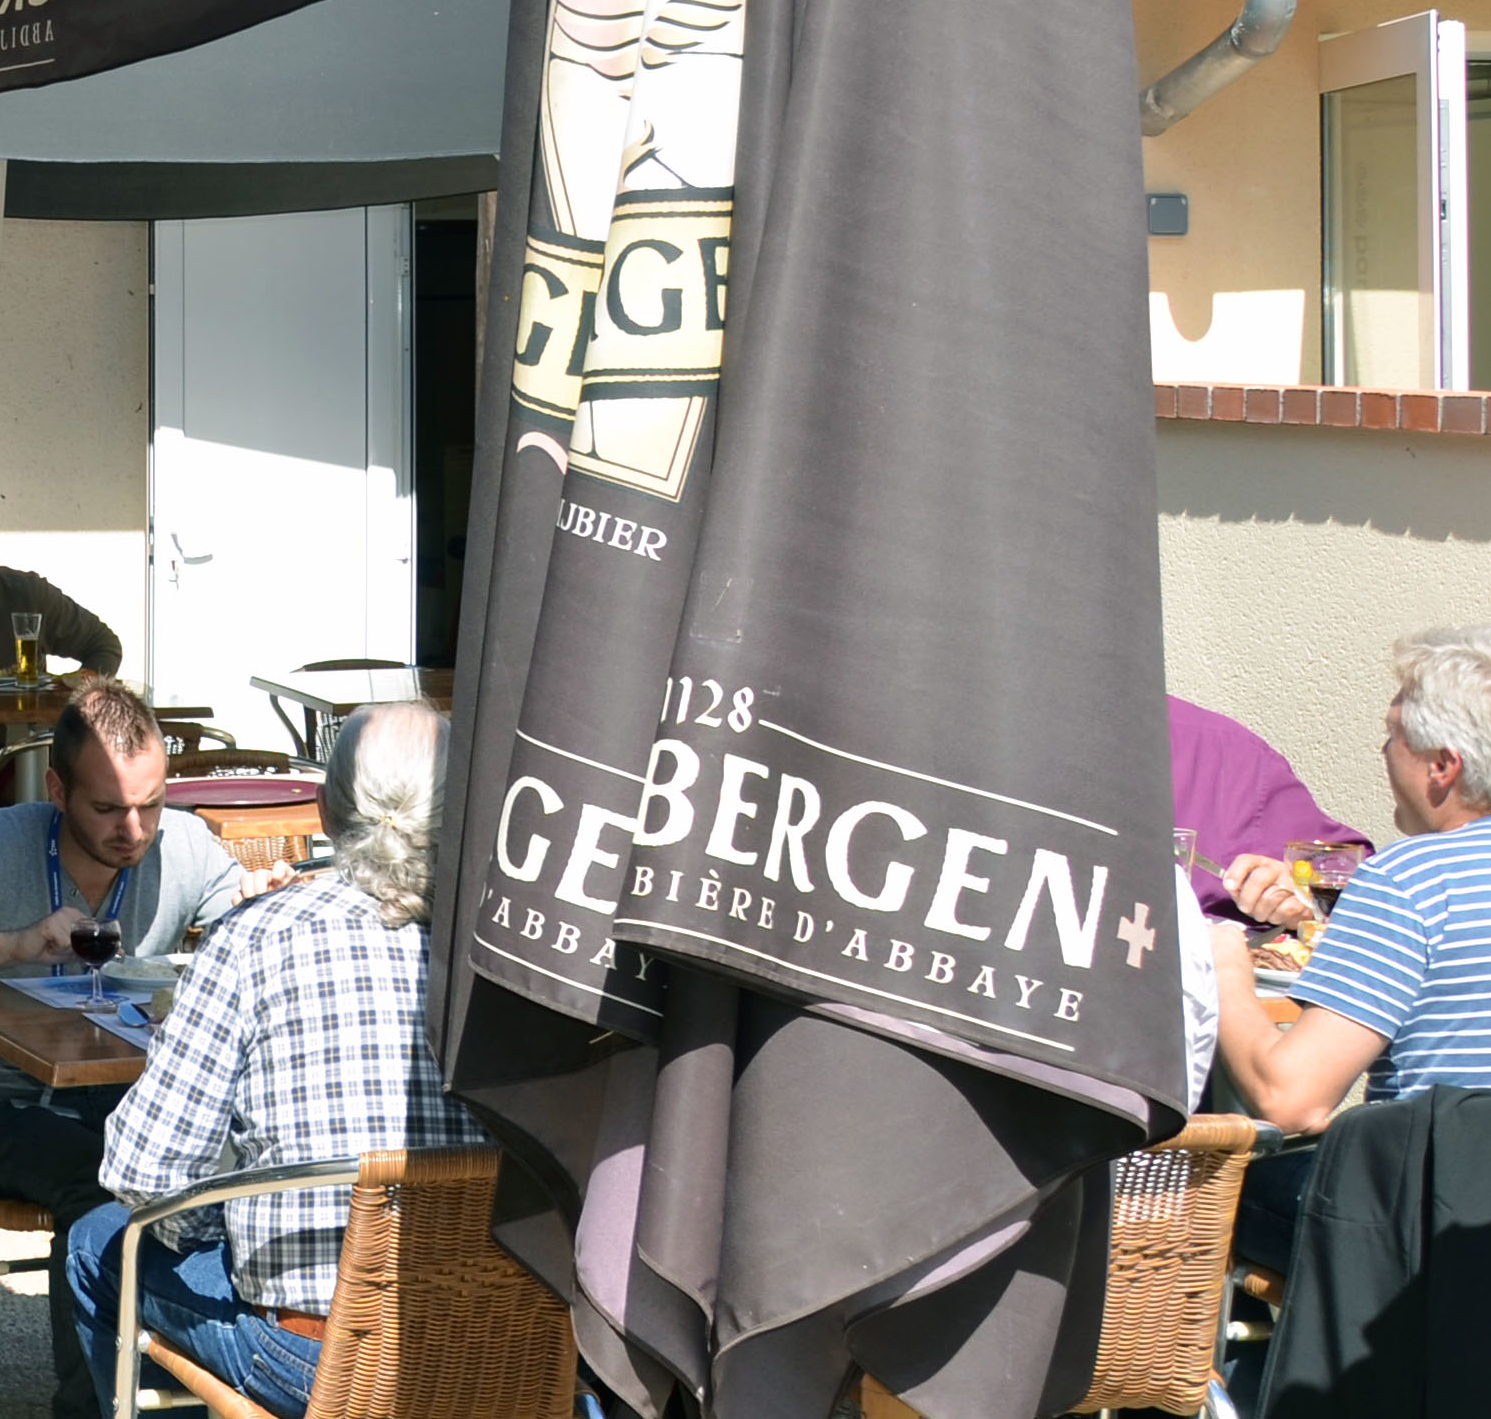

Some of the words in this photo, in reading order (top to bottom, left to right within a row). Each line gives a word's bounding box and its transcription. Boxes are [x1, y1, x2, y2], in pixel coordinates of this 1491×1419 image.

[660, 676, 755, 733] 1128
[631, 867, 777, 931] BIÈRE
[793, 911, 1086, 1023] D'ABBAYE
